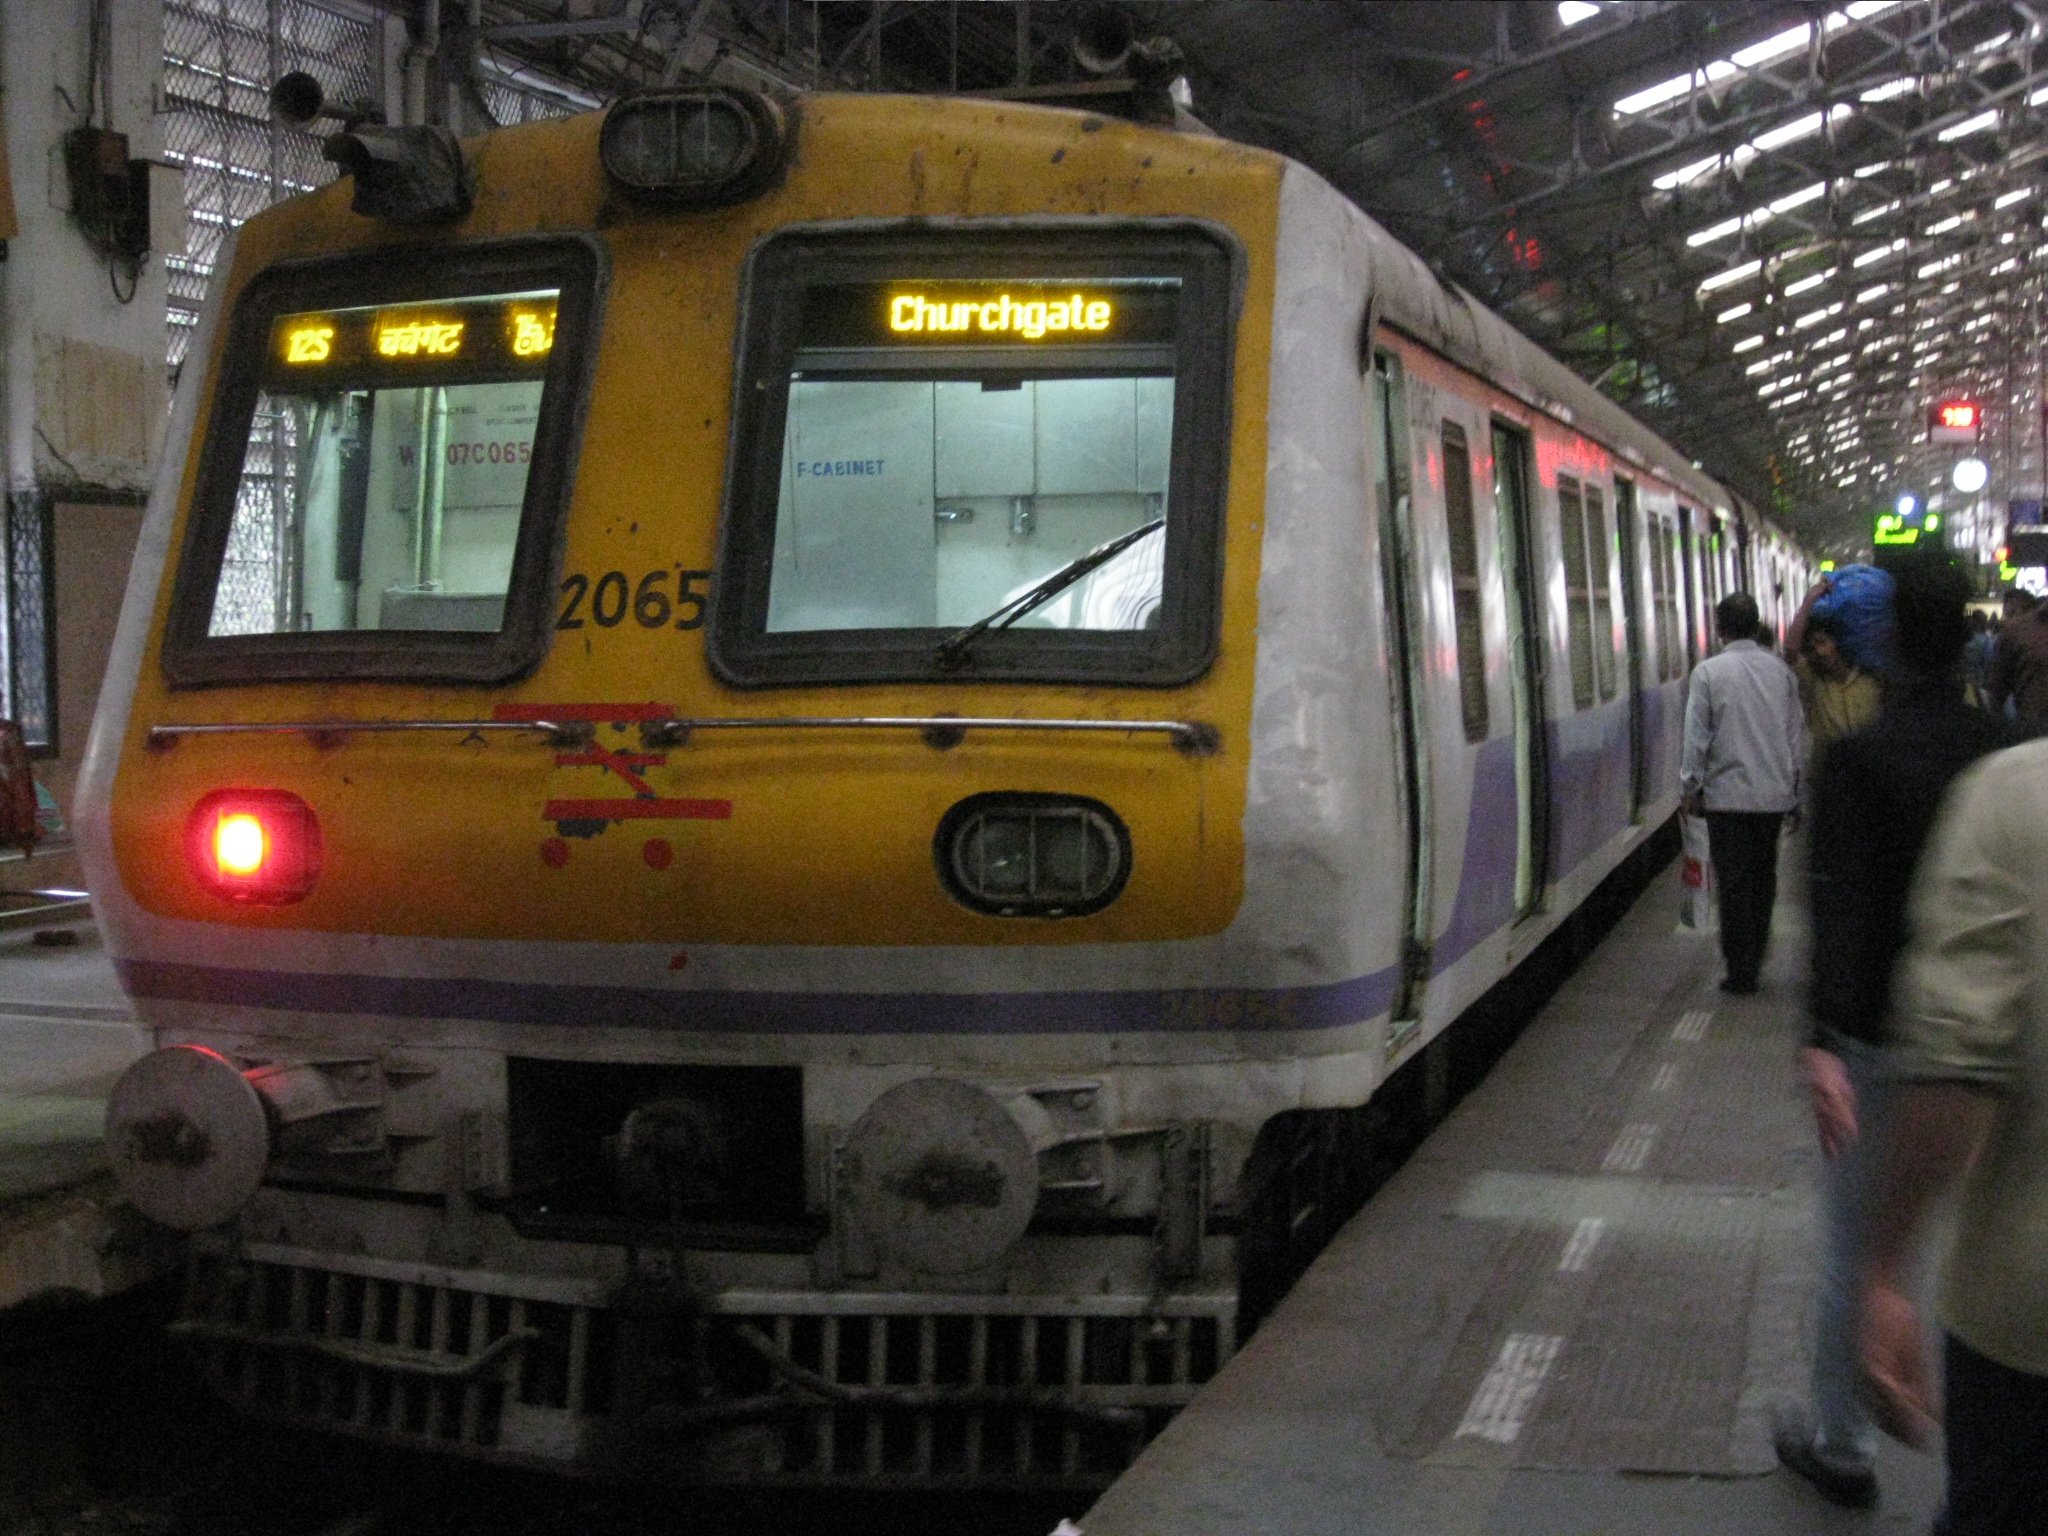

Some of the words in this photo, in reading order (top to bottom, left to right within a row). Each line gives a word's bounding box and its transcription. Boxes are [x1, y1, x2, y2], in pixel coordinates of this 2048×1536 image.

[890, 294, 1112, 339] Churchgate
[287, 328, 334, 362] 12S
[446, 441, 533, 466] 07C065
[556, 570, 717, 631] 2065
